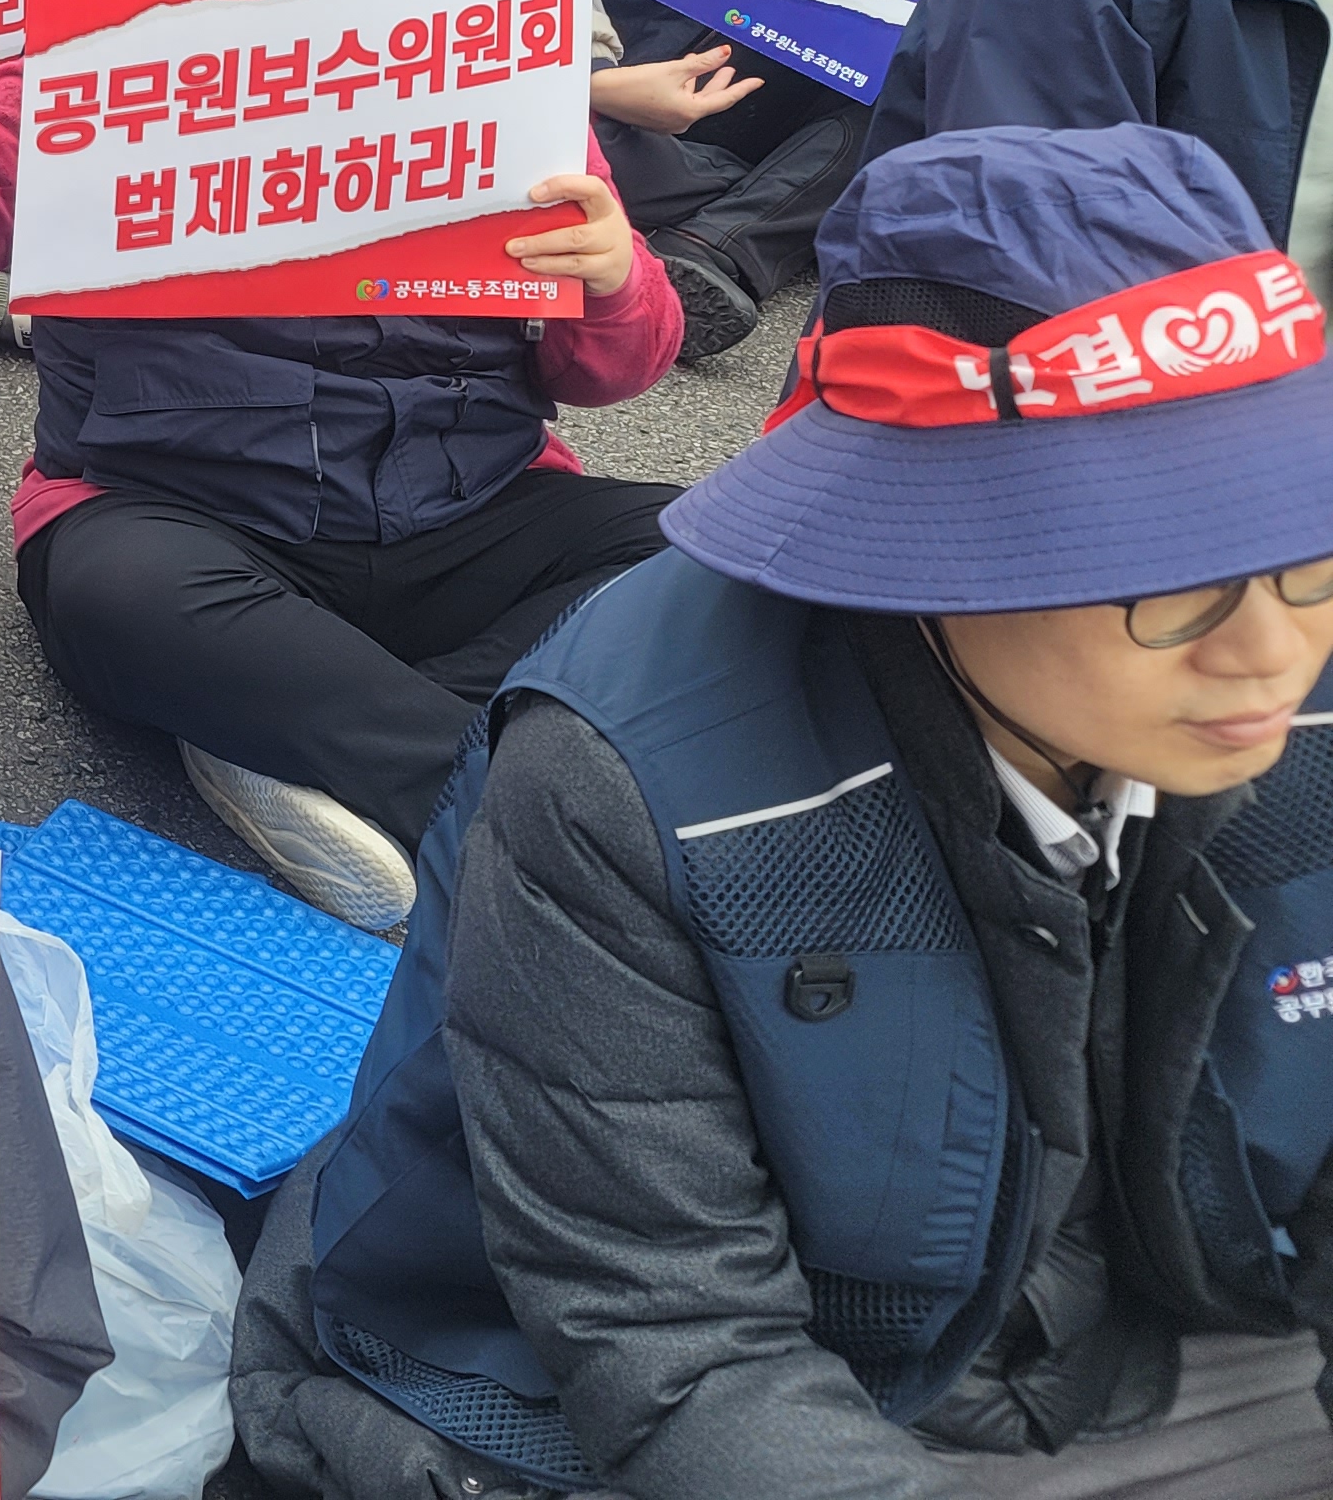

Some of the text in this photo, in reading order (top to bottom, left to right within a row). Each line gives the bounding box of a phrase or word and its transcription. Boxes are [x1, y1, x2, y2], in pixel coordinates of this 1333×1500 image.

[750, 22, 869, 89] 공무원노동조합연맹
[114, 120, 499, 252] 법제화하라!
[393, 276, 560, 302] 공무원노동조합연맹
